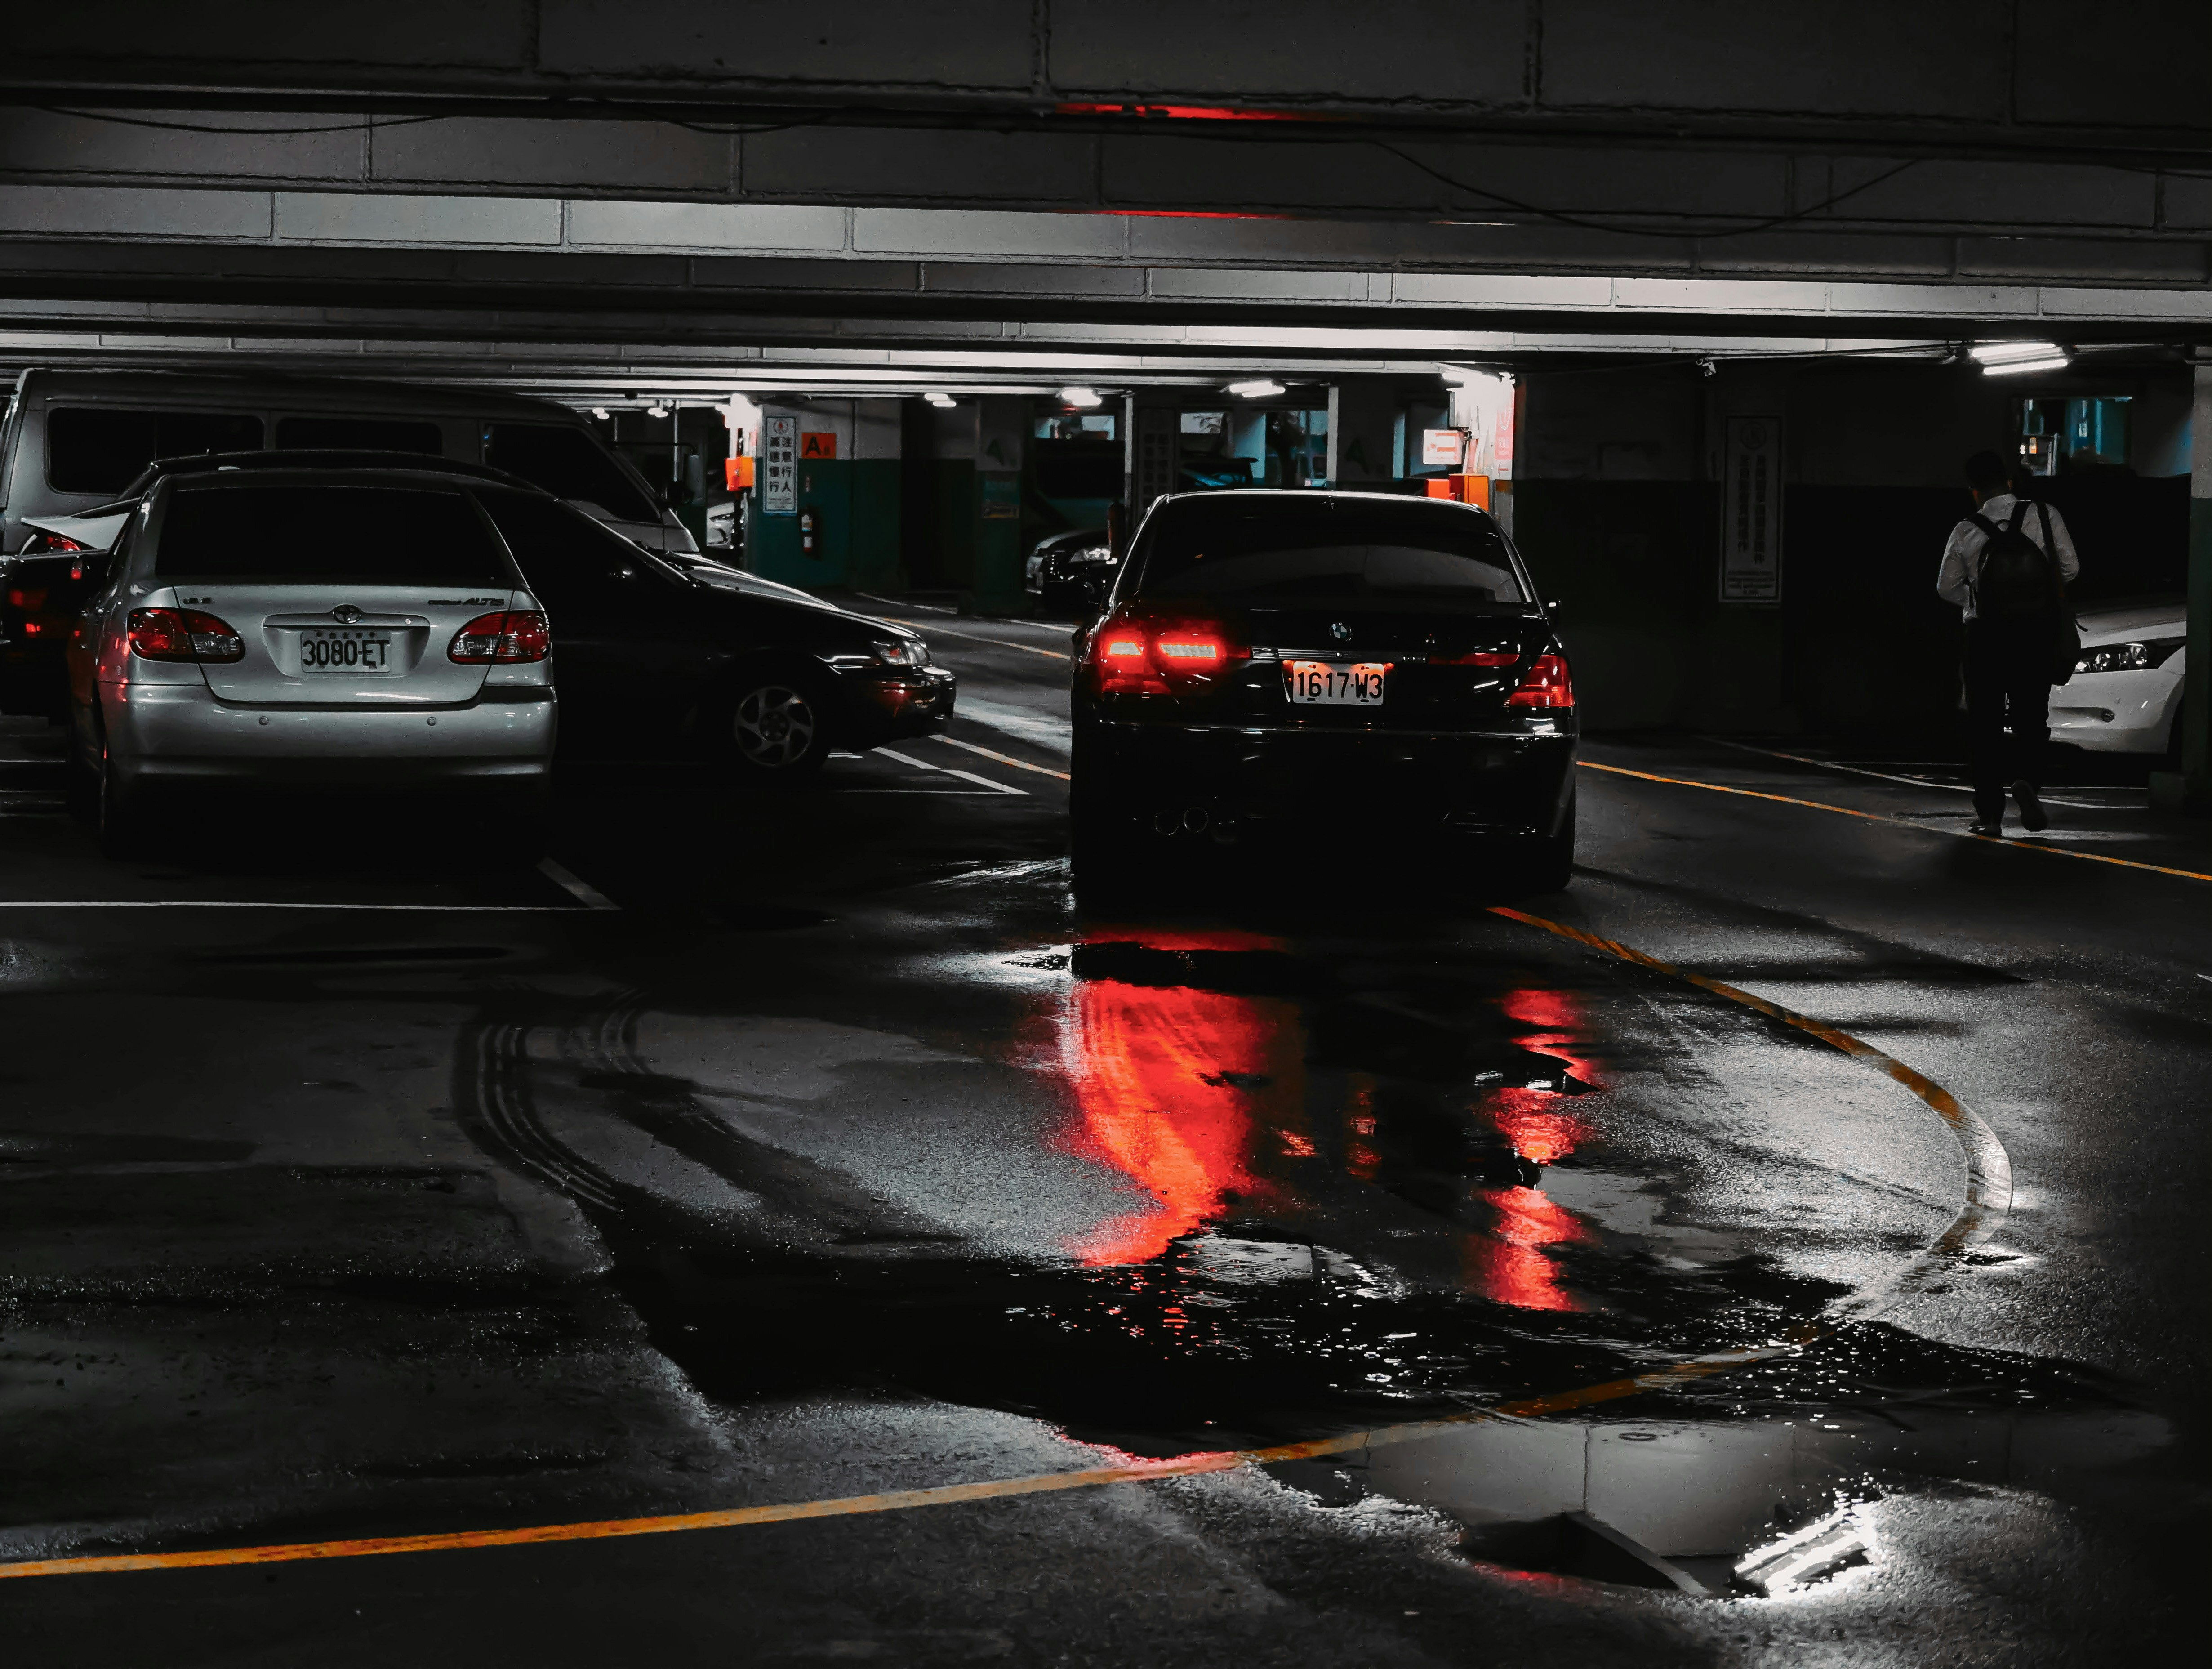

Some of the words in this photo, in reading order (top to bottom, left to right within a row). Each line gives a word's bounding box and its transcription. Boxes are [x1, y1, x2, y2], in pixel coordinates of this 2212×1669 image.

[805, 437, 830, 455] A
[303, 640, 389, 666] 3080-ET
[1298, 672, 1383, 699] 1617-W3
